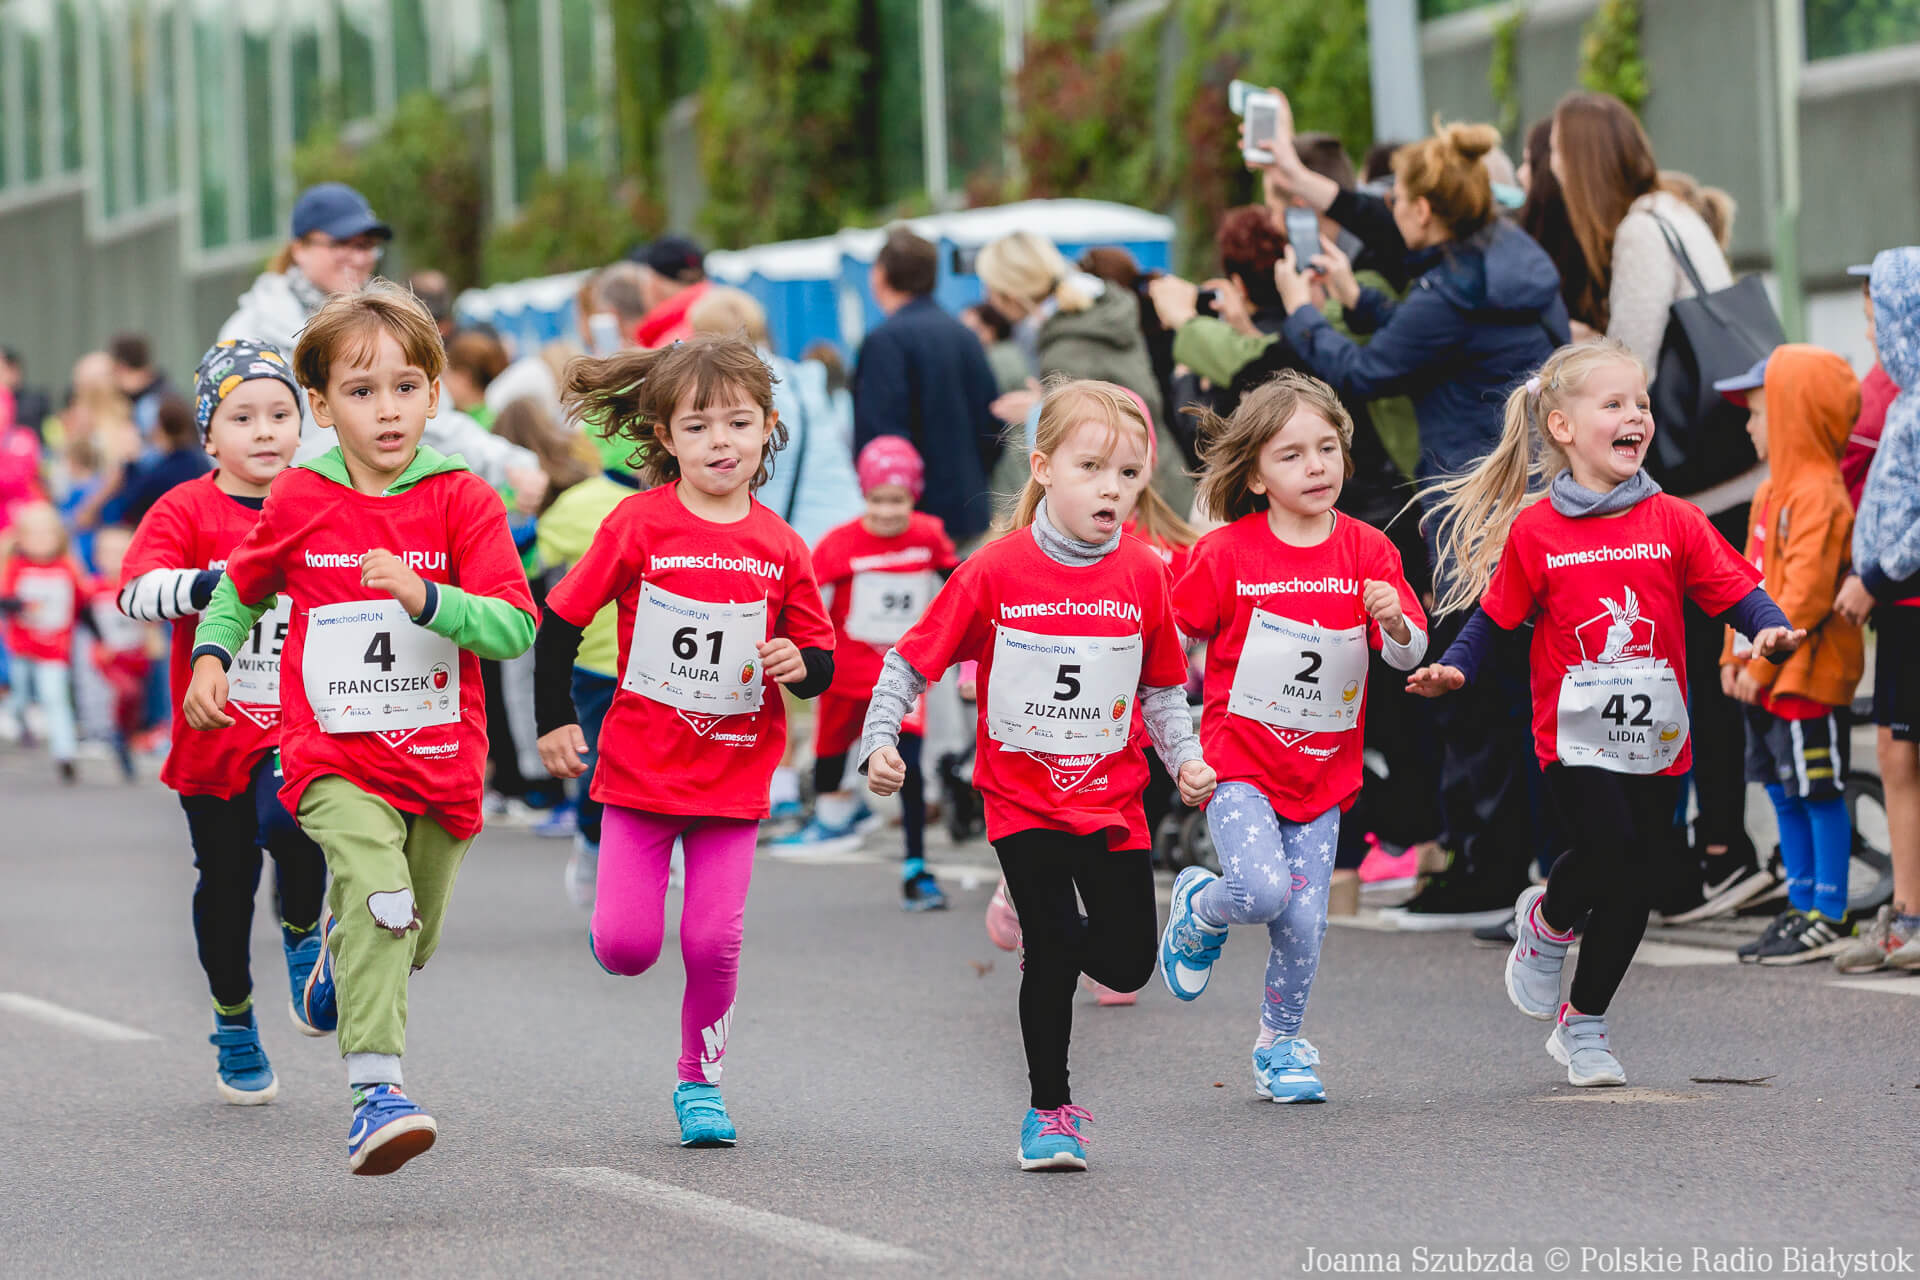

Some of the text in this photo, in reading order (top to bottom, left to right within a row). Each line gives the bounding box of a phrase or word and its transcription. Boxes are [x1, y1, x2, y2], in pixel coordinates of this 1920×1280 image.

[651, 552, 784, 581] homeschoolRUN
[316, 612, 383, 626] homeschoolRUN
[650, 596, 710, 621] homeschoolRUN
[1000, 598, 1142, 623] homeschoolRUN
[1261, 620, 1321, 644] homeschoolRUN
[364, 632, 396, 672] 4
[672, 626, 724, 664] 61
[1006, 638, 1076, 655] homeschoolRUN
[670, 661, 720, 683] LAURA
[1294, 650, 1322, 684] 2
[328, 675, 430, 696] FRANCISZEK
[1053, 664, 1081, 701] 5
[1282, 683, 1322, 701] MAJA
[1574, 677, 1633, 688] homeschoolRUN
[1024, 702, 1101, 720] ZUZANNA
[1601, 693, 1653, 726] 42
[1608, 730, 1646, 743] LIDIA
